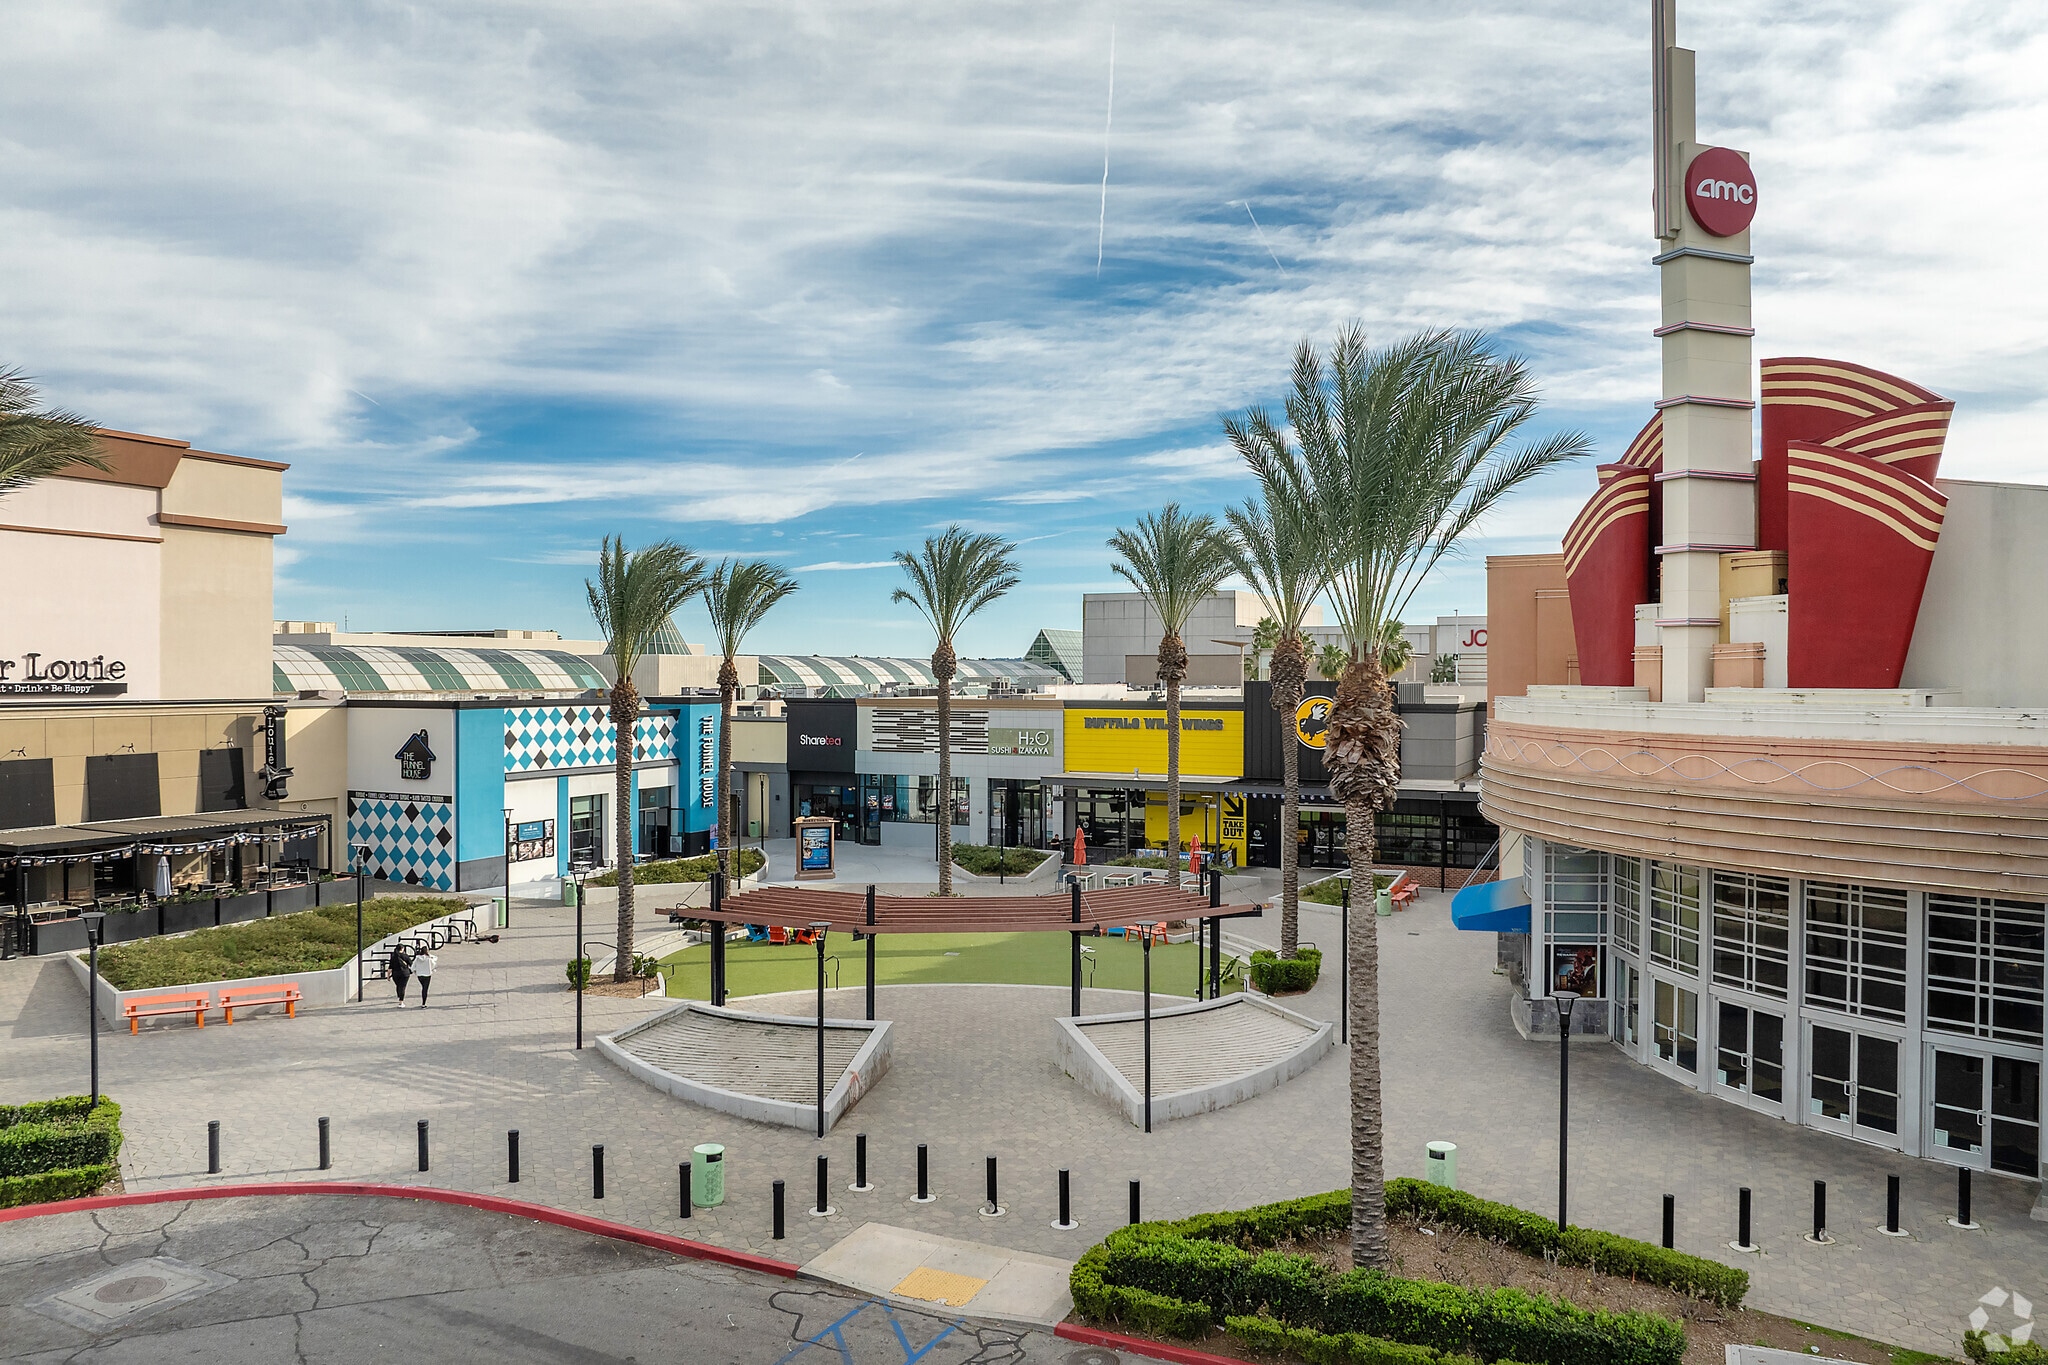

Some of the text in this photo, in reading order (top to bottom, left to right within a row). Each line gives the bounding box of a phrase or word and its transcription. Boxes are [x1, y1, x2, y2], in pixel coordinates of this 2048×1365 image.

[1696, 178, 1754, 205] amc
[27, 653, 126, 680] Louie
[14, 684, 44, 693] Drink
[51, 684, 63, 693] Be
[1084, 717, 1224, 731] BUFFALO WIL WINGS
[267, 717, 275, 765] Louie
[800, 734, 841, 745] Sharetea
[991, 746, 1012, 754] SUSHI
[1019, 746, 1049, 755] IZAKAYA
[403, 751, 415, 761] THE
[403, 760, 425, 770] FUNNEL
[702, 715, 714, 809] THE FUNNEL HOUSE
[403, 769, 421, 779] HOUSE
[1223, 828, 1244, 837] OUT
